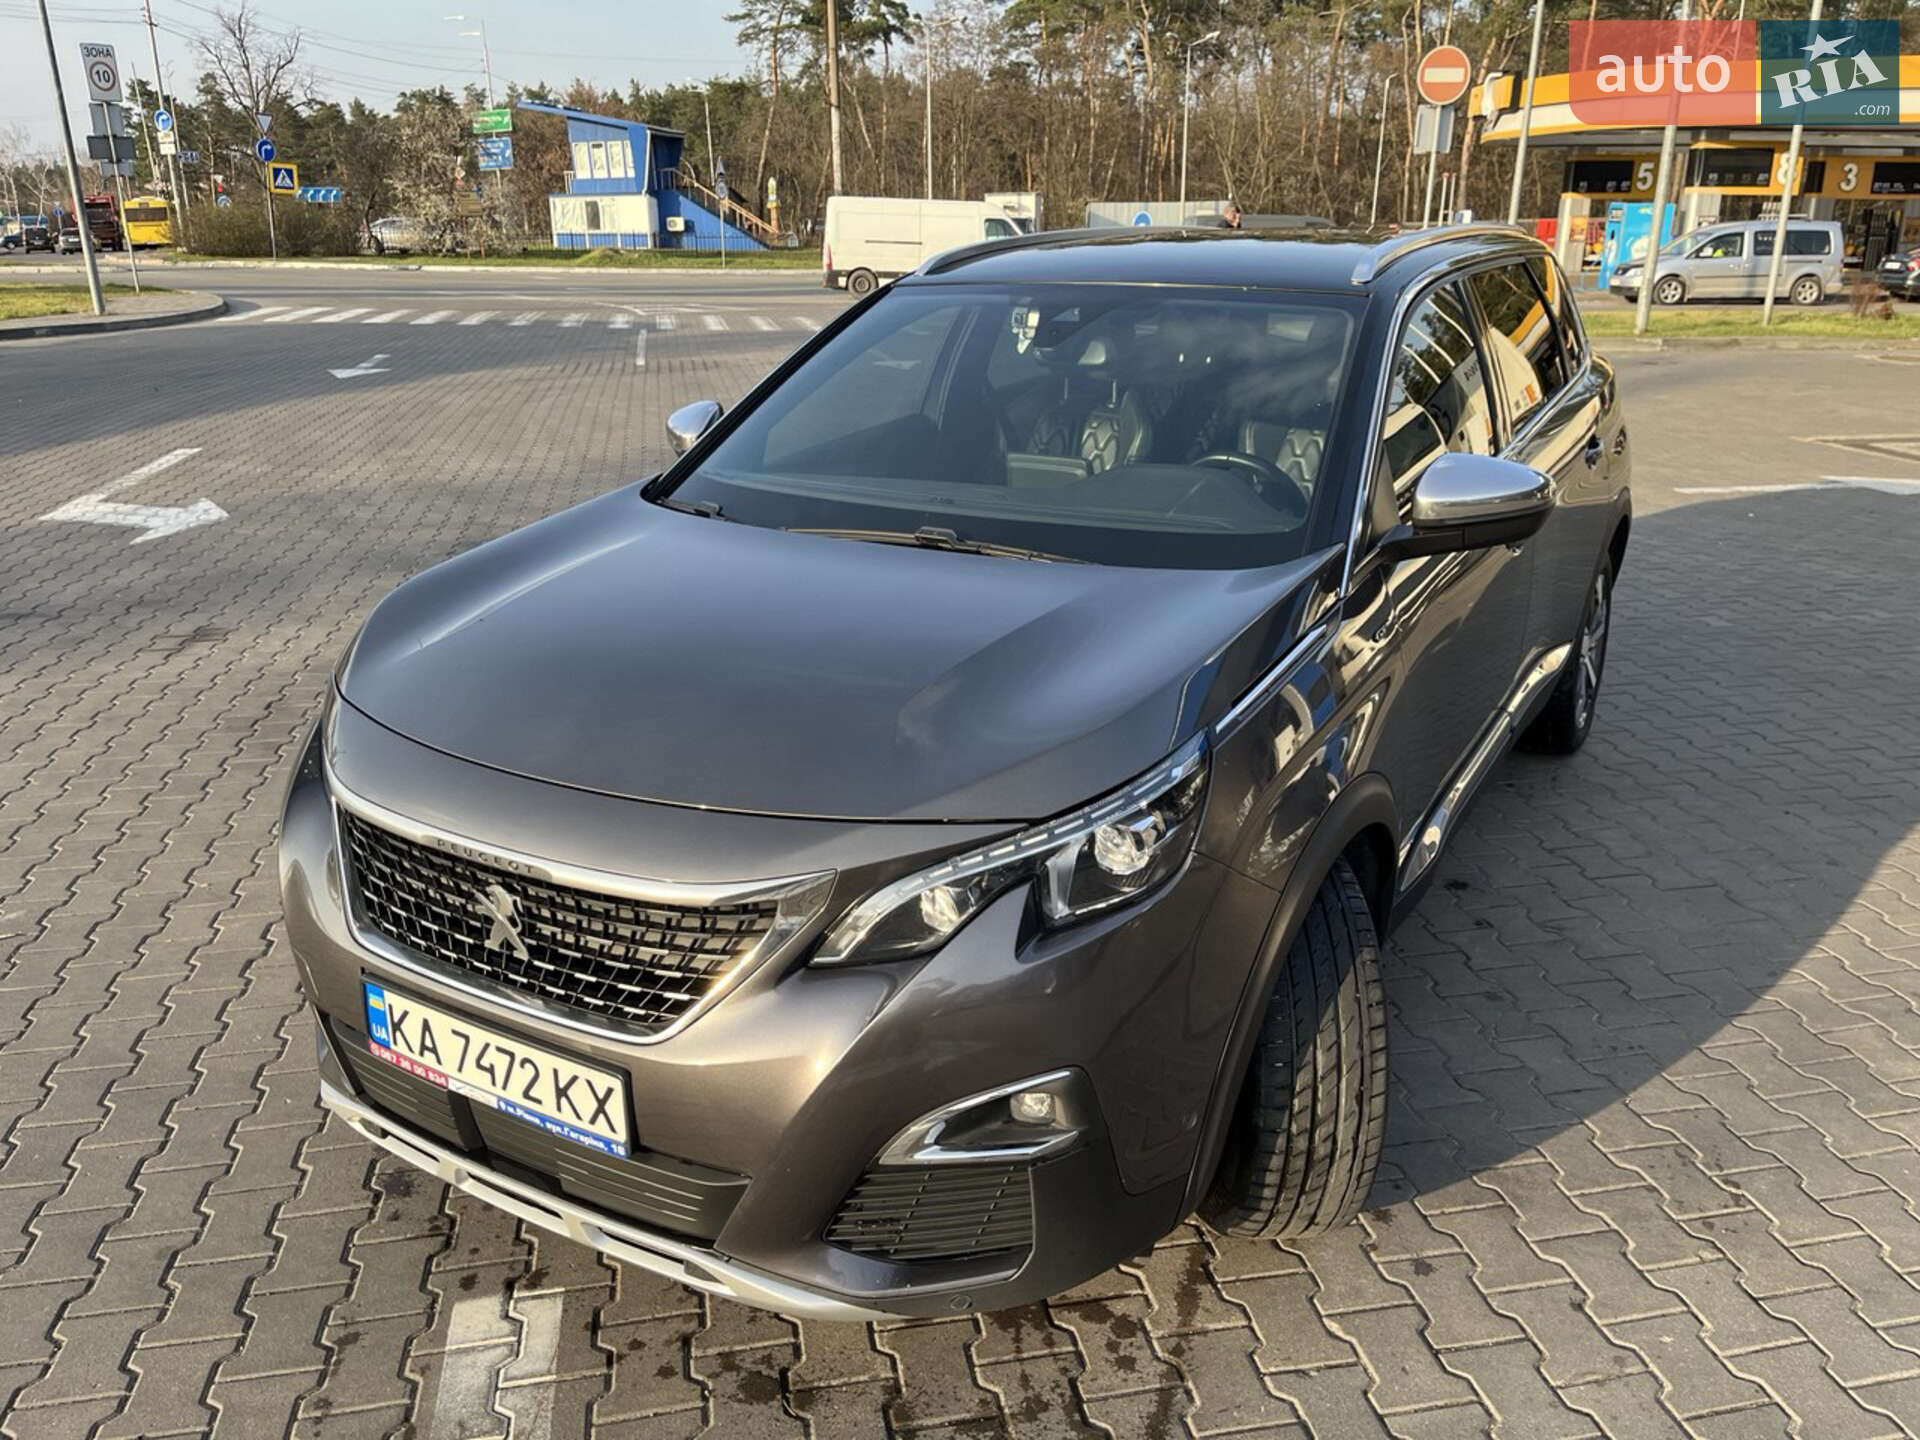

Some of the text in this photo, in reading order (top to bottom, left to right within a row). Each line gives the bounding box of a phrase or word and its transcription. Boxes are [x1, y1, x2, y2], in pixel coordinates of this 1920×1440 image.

[84, 47, 112, 58] ЗОНА
[95, 69, 111, 83] 10
[1636, 162, 1655, 191] 5
[1840, 163, 1858, 191] 3
[437, 839, 534, 874] PEUGEOT
[372, 1023, 389, 1041] UA
[388, 1003, 617, 1134] KA 7472 KX
